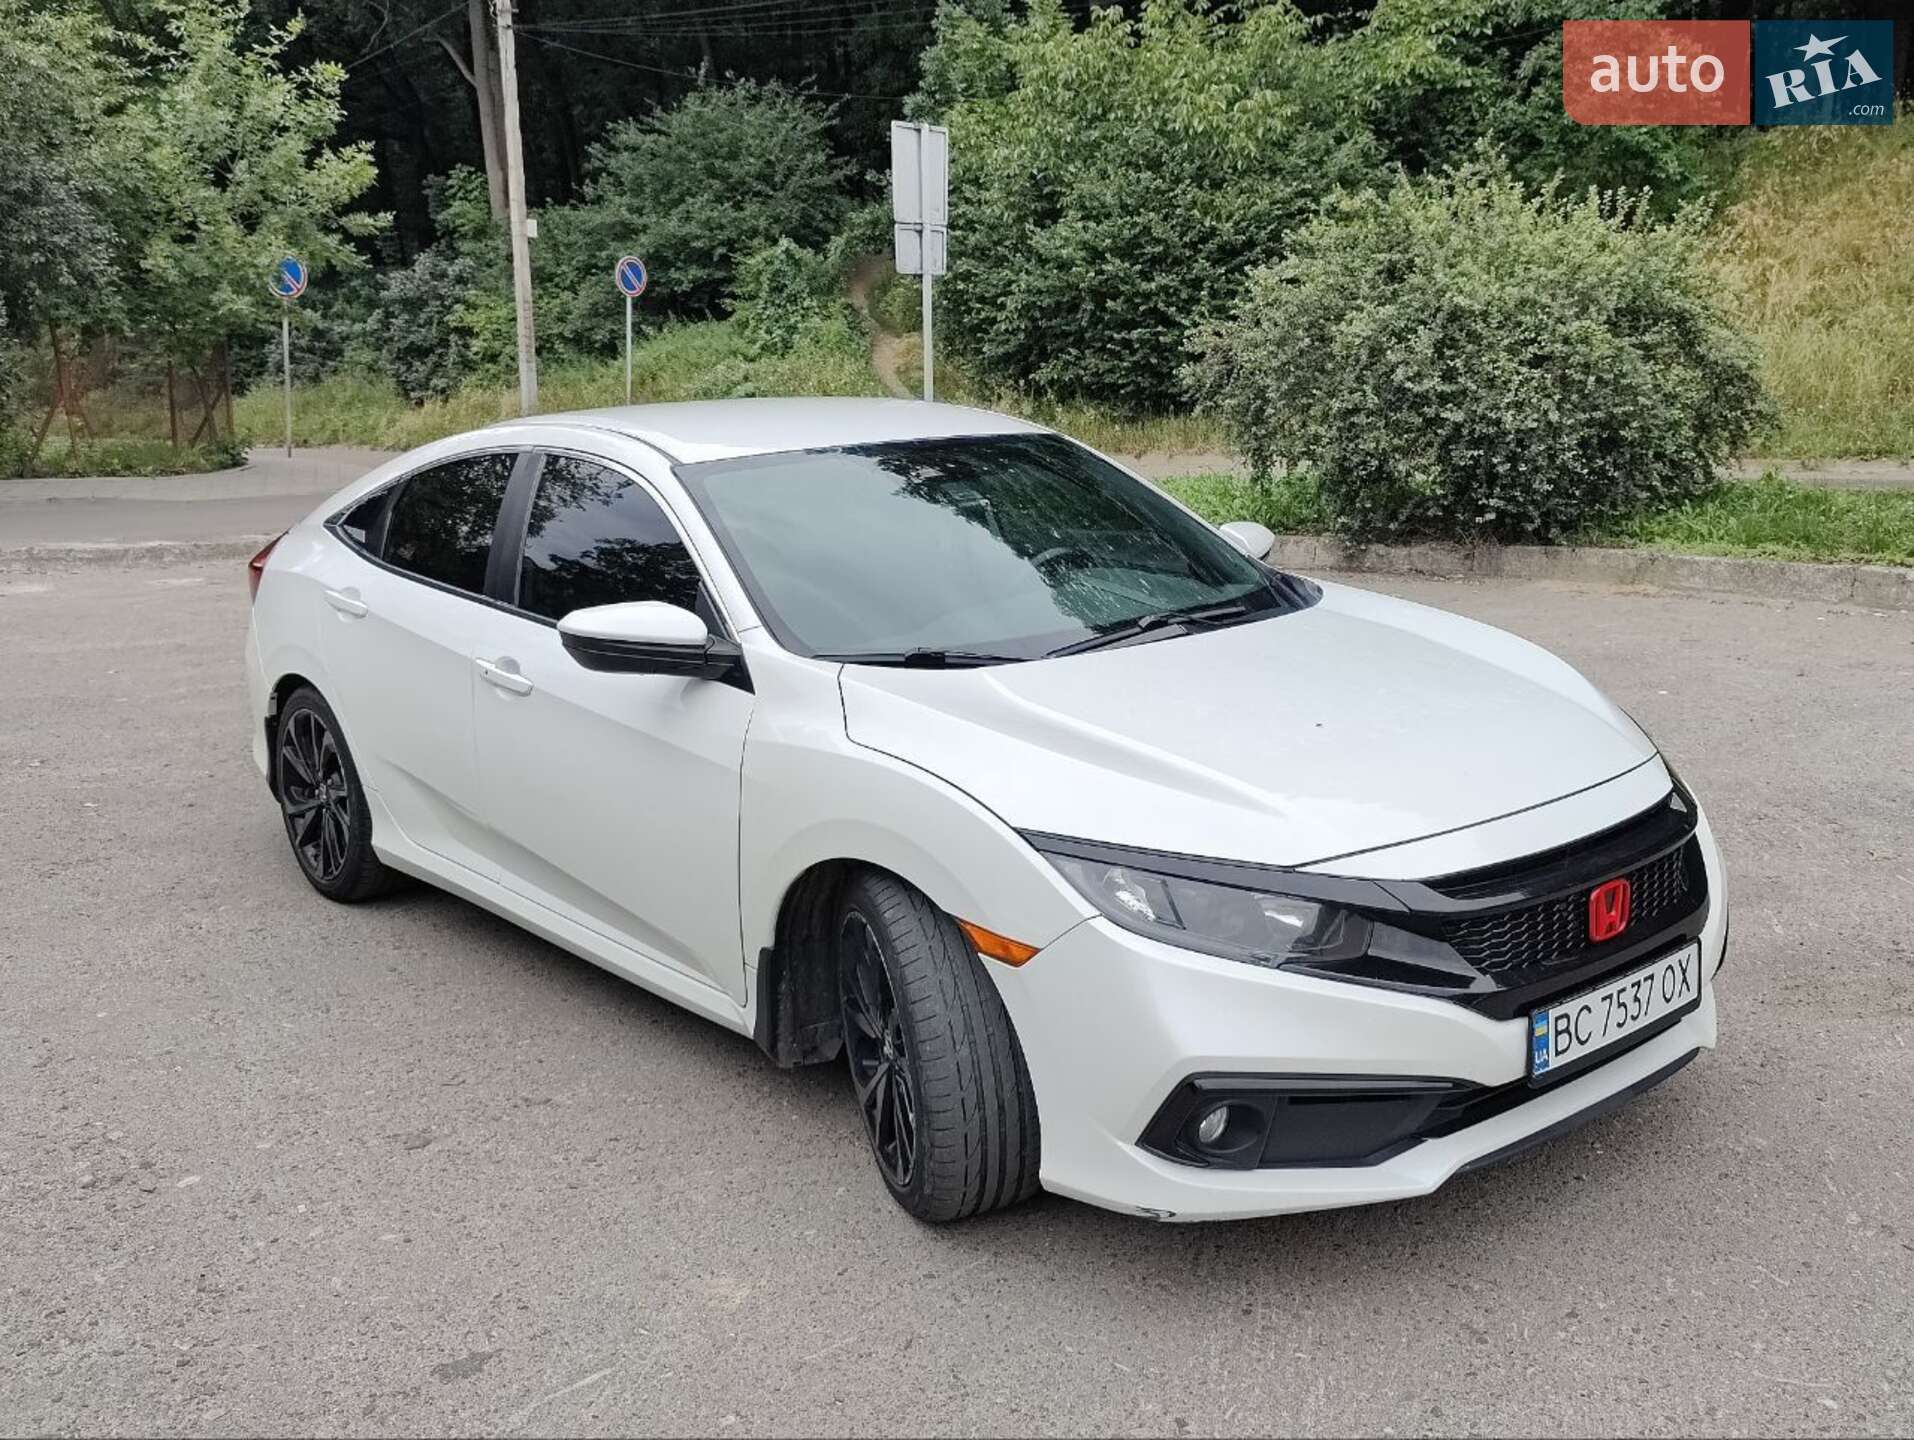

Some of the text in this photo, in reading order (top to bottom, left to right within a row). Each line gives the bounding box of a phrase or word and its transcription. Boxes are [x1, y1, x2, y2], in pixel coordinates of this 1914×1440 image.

[1554, 954, 1691, 1057] BC 7537 OX
[1534, 1049, 1549, 1063] UA
